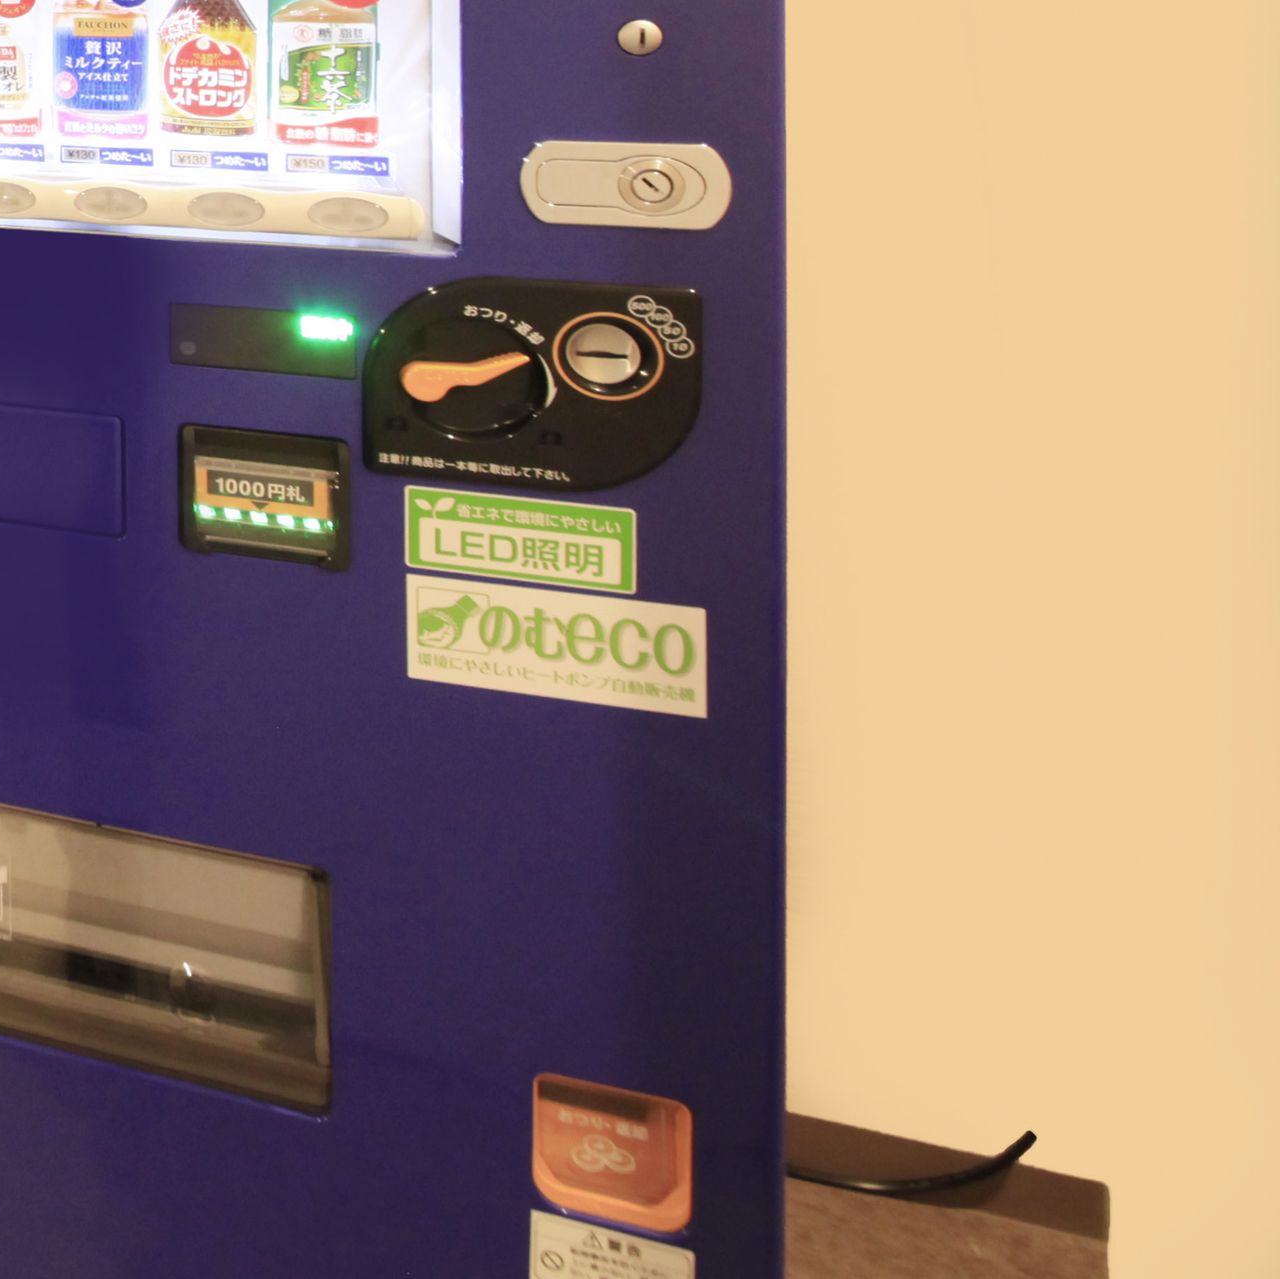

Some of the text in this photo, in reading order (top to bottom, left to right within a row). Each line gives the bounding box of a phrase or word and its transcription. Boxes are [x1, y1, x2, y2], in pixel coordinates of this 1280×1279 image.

[77, 20, 129, 30] FAUCHON
[85, 40, 123, 56] 贅沢
[64, 55, 144, 70] ミルクティー
[78, 71, 129, 83] アイス仕立て
[168, 65, 247, 88] ドデカミン
[316, 44, 353, 115] 十六茶
[172, 86, 245, 108] ストロング
[177, 154, 208, 165] ¥130
[292, 158, 325, 170] ¥150
[631, 301, 654, 312] 500
[662, 325, 681, 336] 50
[671, 342, 689, 353] 10
[215, 476, 307, 504] 1000円札
[456, 503, 623, 535] 省エネで環境にやさしい
[433, 526, 605, 578] LED照明
[478, 604, 694, 677] のむeco
[416, 650, 697, 703] 環境にやさしいヒートポンプ自動販売機
